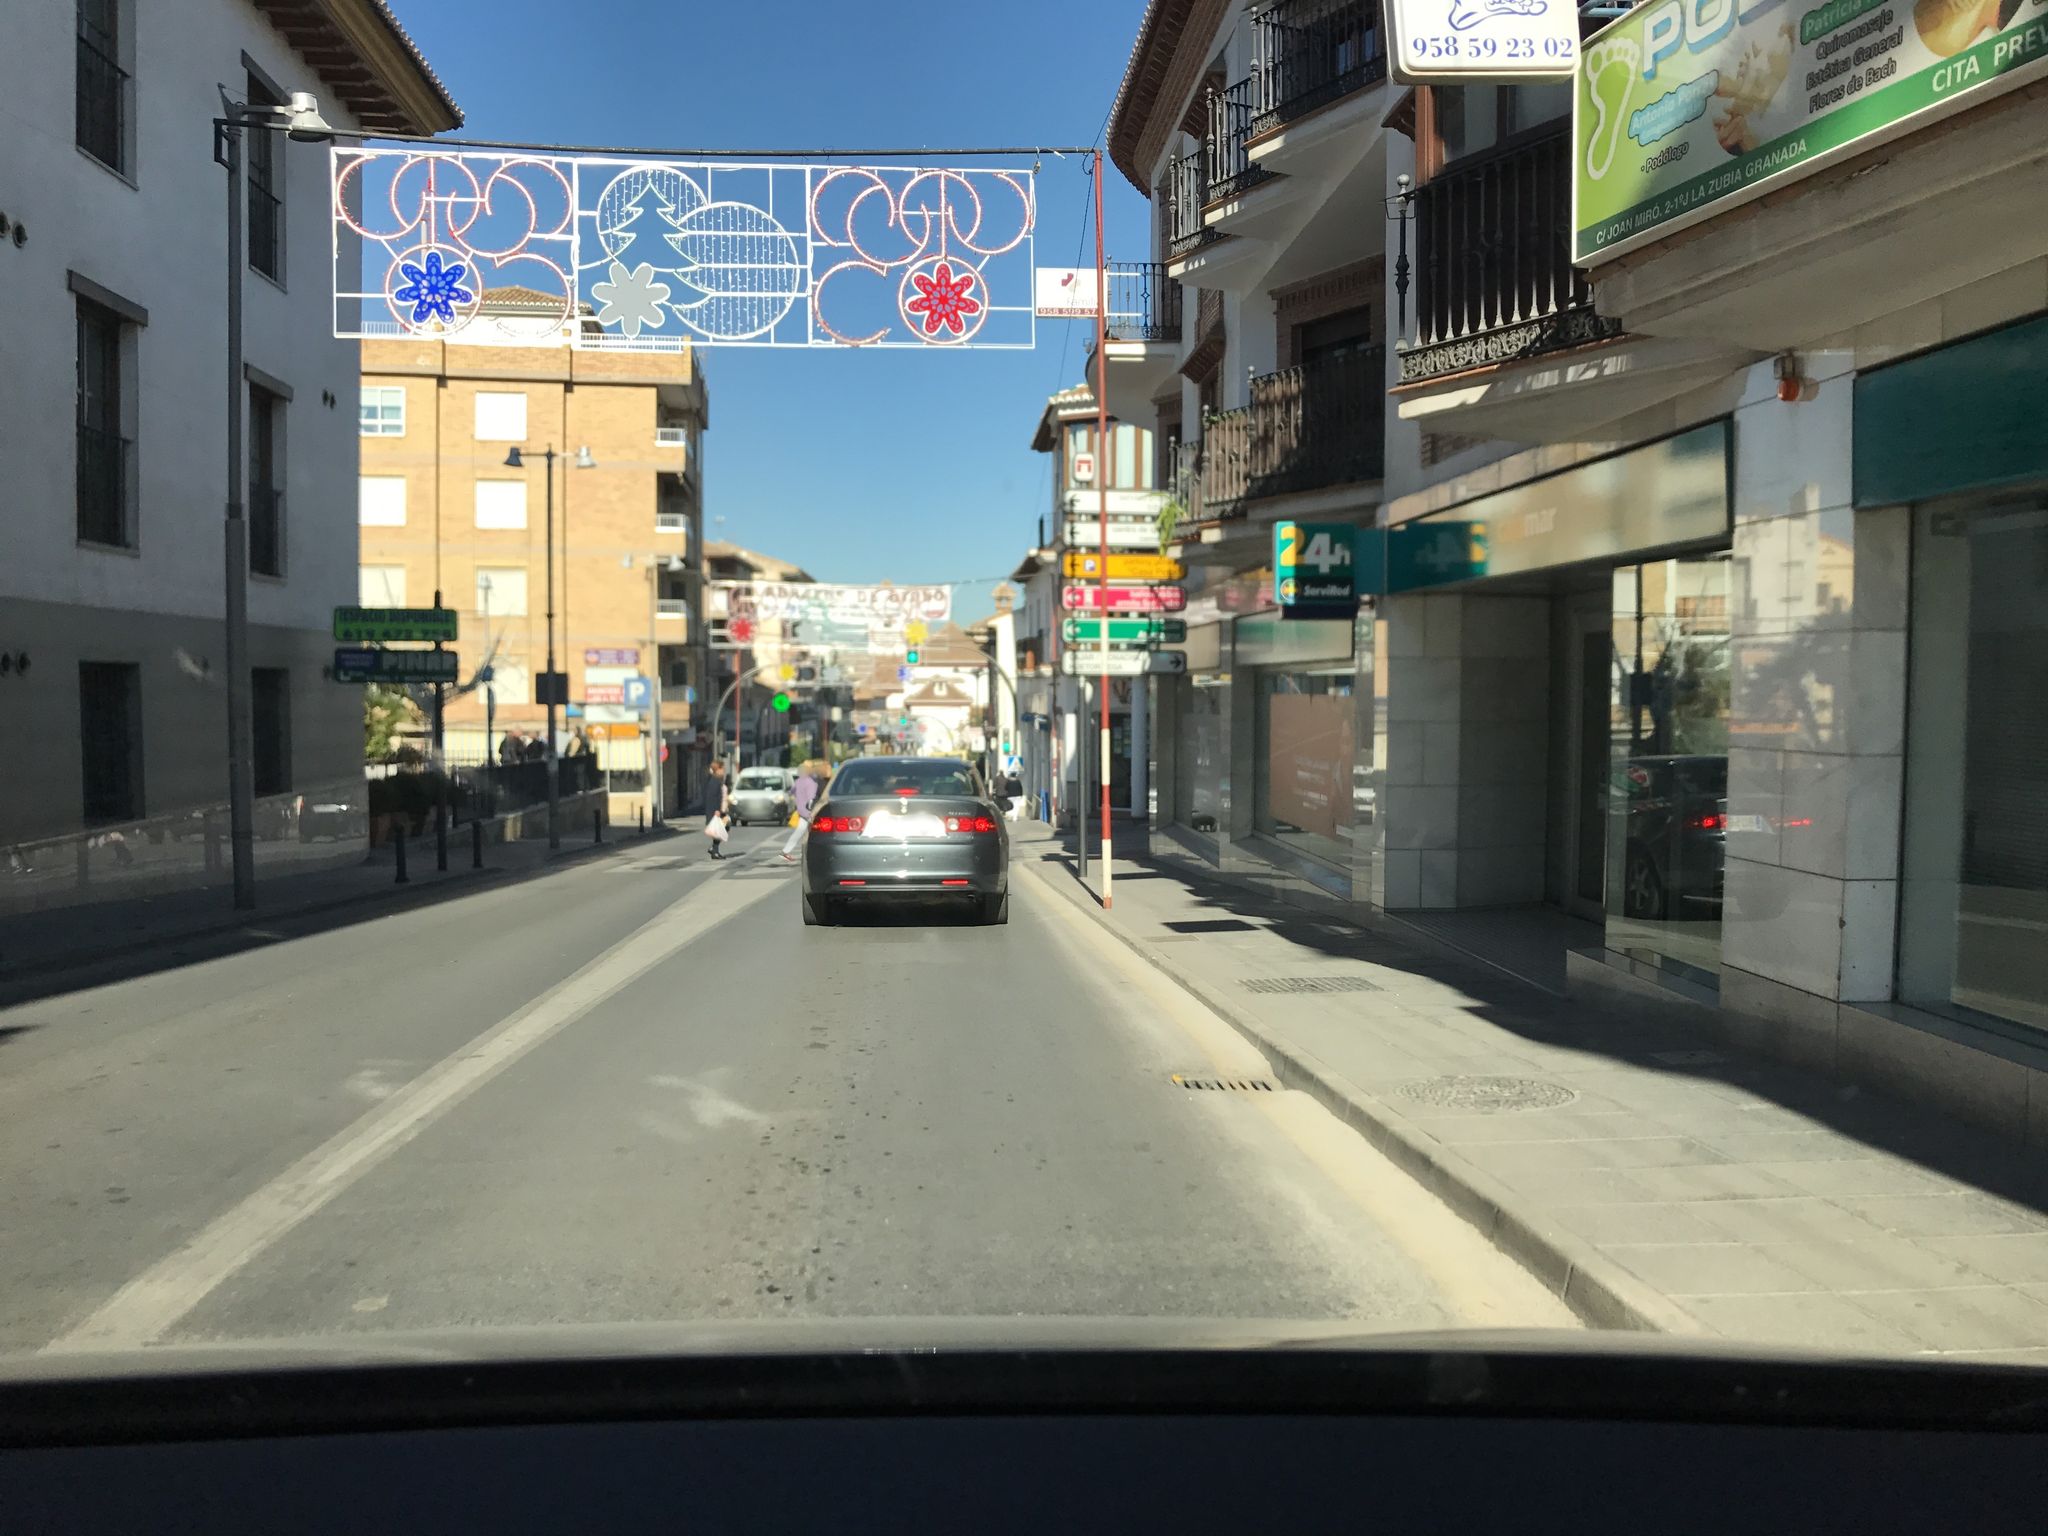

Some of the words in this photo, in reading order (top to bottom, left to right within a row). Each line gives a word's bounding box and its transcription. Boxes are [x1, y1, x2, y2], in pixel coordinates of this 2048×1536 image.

[1413, 36, 1459, 58] 958
[1468, 38, 1497, 58] 59
[1506, 38, 1535, 58] 23
[1544, 37, 1573, 58] 02
[1806, 57, 1851, 91] Estética
[1854, 25, 1903, 66] General
[1816, 9, 1893, 60] Quiromasaje
[1809, 84, 1845, 113] Flores
[1847, 75, 1863, 95] de
[1866, 57, 1897, 87] Bach
[1932, 54, 1980, 92] CITA
[1607, 217, 1633, 240] JOAN
[1690, 183, 1705, 202] LA
[1708, 168, 1742, 195] ZUBIA
[1745, 139, 1807, 178] GRANADA
[1280, 525, 1350, 574] 24h
